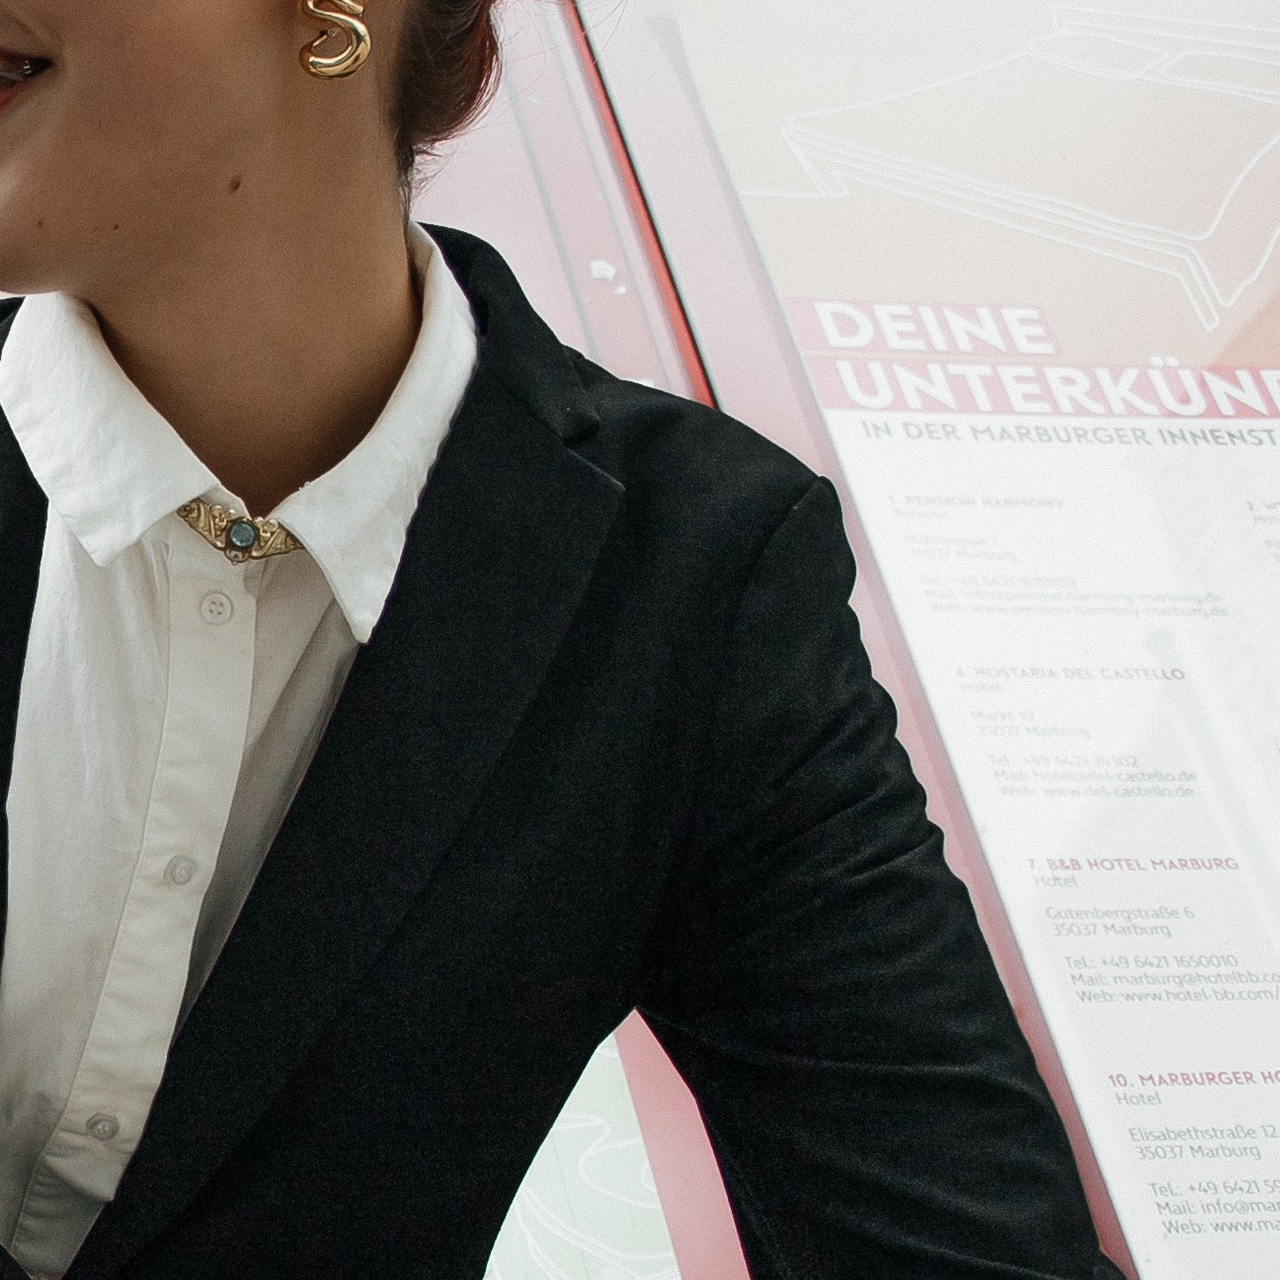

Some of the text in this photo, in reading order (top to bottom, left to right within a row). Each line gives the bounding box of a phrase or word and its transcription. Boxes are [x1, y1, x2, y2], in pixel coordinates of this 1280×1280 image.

[814, 300, 1056, 354] DEINE
[862, 421, 893, 439] IN
[902, 422, 963, 442] DER
[970, 424, 1152, 446] MARBURGER
[1100, 668, 1187, 681] CASTELLO
[1046, 858, 1082, 871] B&B
[1086, 858, 1147, 871] HOTEL
[1150, 857, 1239, 871] MARBURG
[1034, 875, 1078, 888] Hotel
[1045, 906, 1195, 921] Gutenbergstraße 6
[1051, 923, 1172, 938] 35037 Marburg
[1101, 956, 1130, 968] +49
[1134, 955, 1170, 968] 6421
[1076, 989, 1120, 1003] Web:
[1108, 1073, 1134, 1087] 10.
[1138, 1071, 1257, 1087] MARBURGER
[1115, 1091, 1162, 1106] Hotel
[1128, 1124, 1258, 1142] Elisabethstraße
[1137, 1144, 1262, 1160] 35037 Marburg
[1188, 1181, 1218, 1196] +49
[1222, 1179, 1261, 1194] 6421
[1155, 1200, 1197, 1216] Mail:
[1161, 1219, 1206, 1234] Web:
